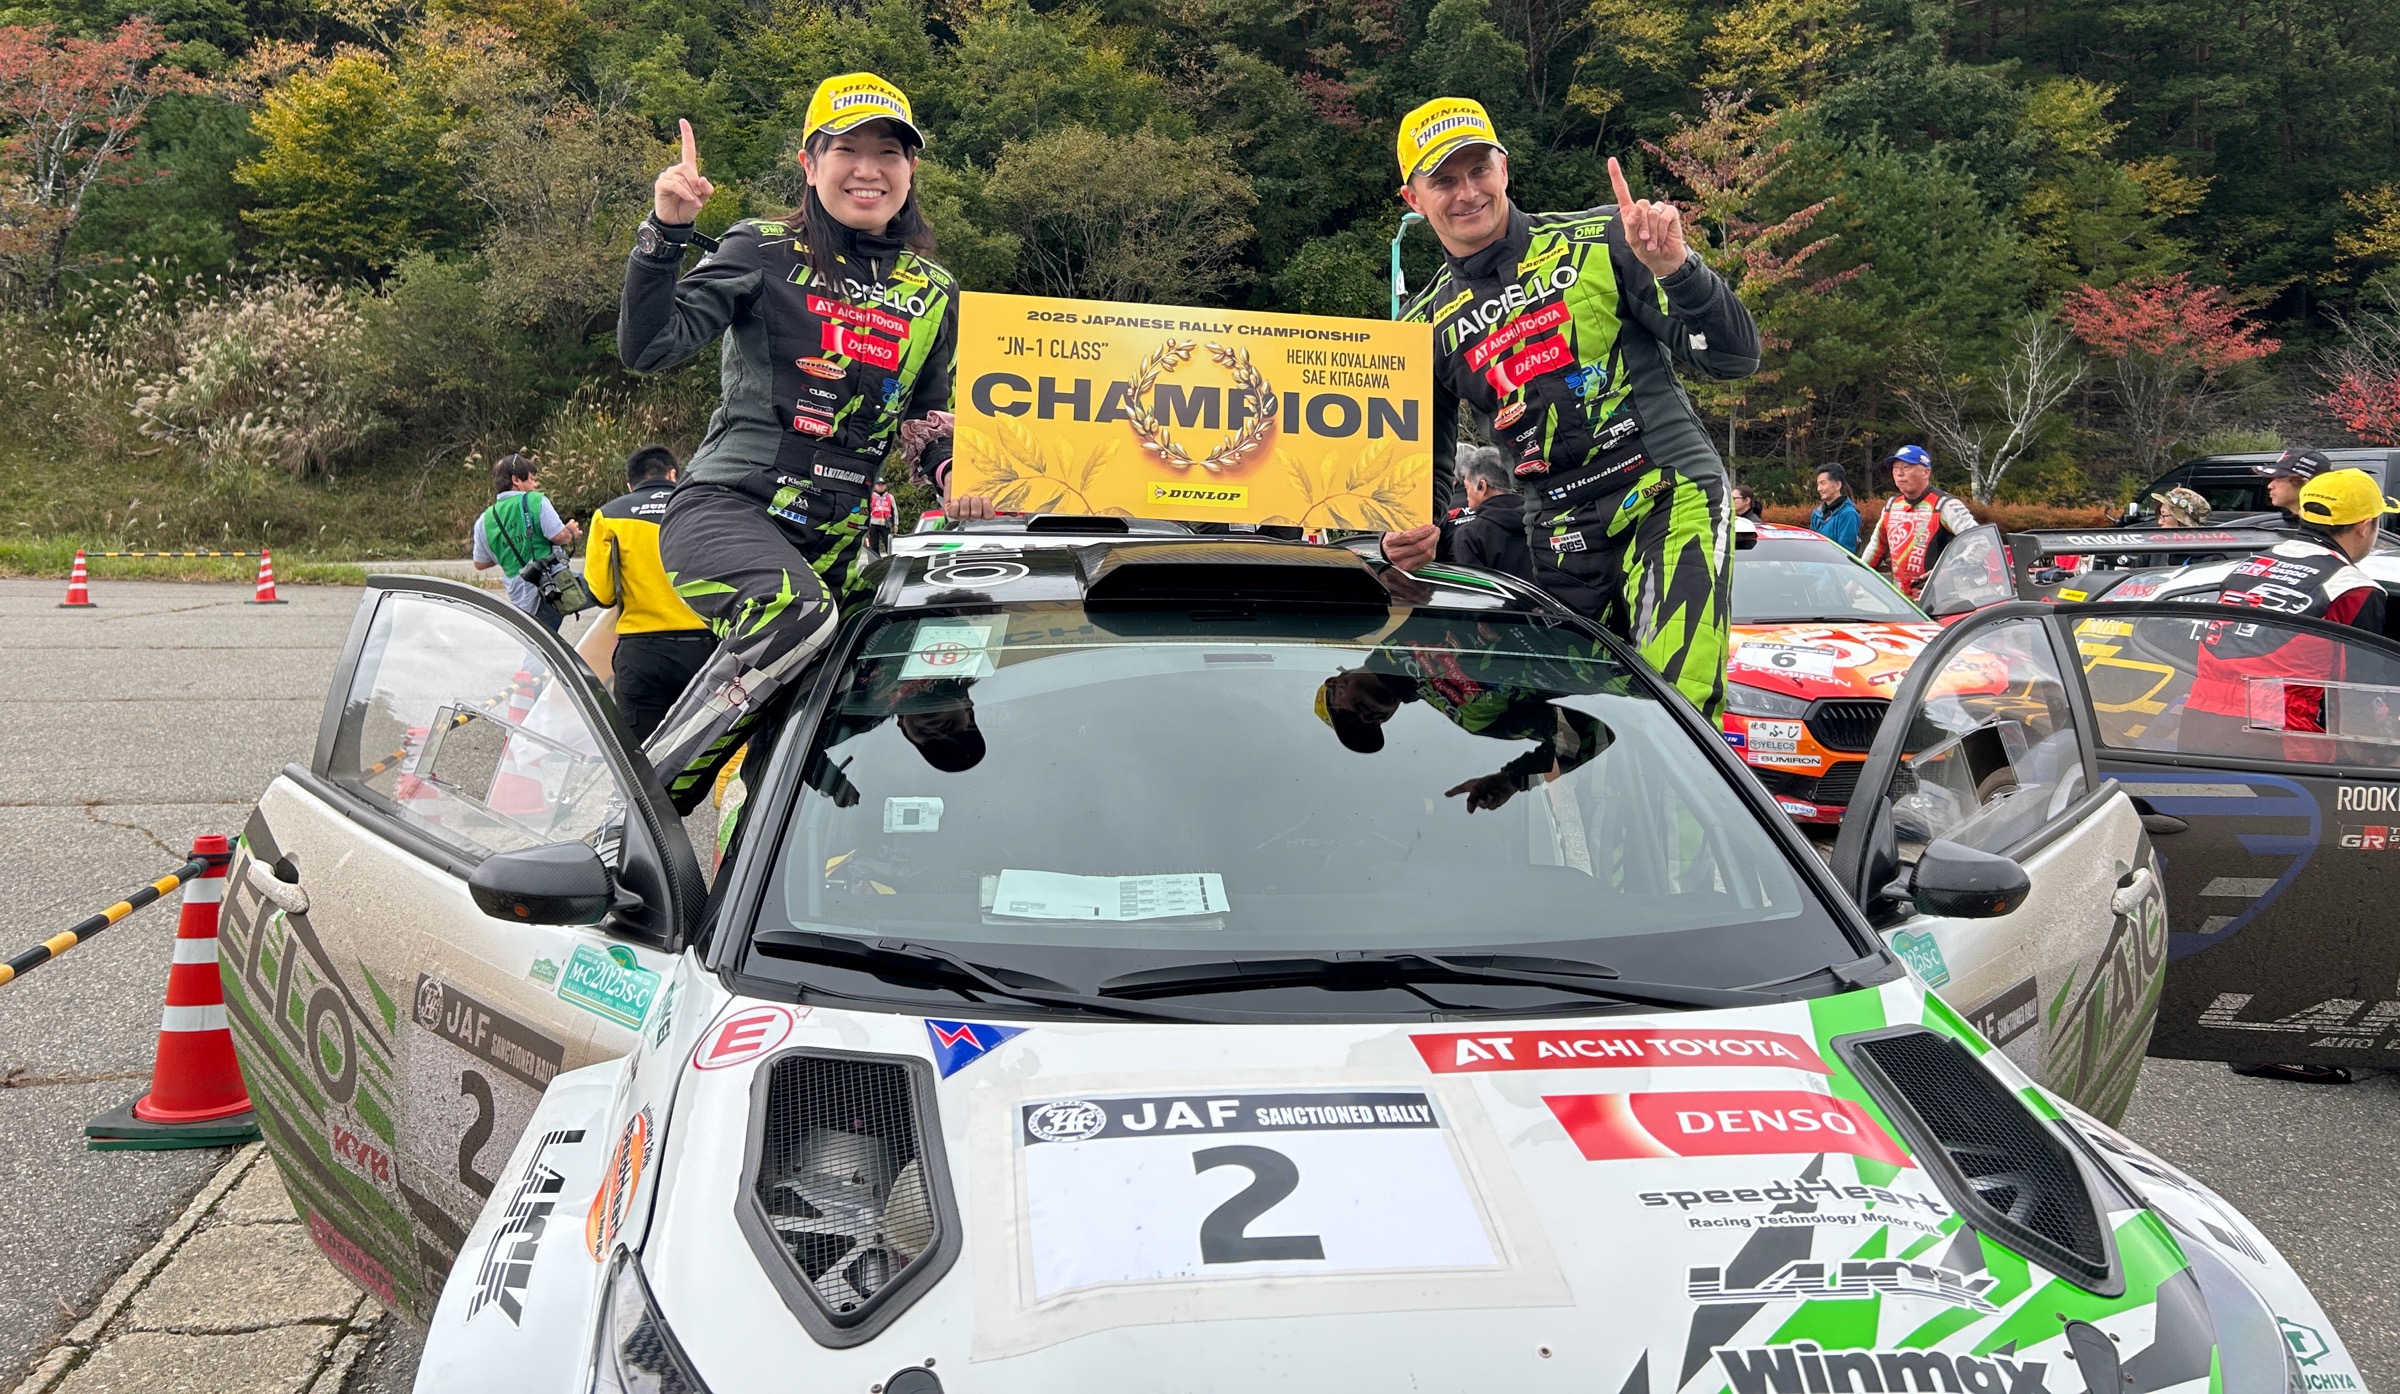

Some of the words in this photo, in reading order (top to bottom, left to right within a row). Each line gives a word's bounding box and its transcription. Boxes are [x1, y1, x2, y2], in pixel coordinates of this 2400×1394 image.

[841, 84, 905, 104] DUNLOP
[833, 94, 907, 120] CHAMPION
[1419, 107, 1480, 130] DUNLOP
[1416, 116, 1485, 150] CHAMPION
[759, 225, 785, 234] OMP
[1574, 225, 1605, 238] OMP
[1526, 247, 1564, 269] DUNLOP
[929, 270, 950, 286] OMP
[815, 300, 835, 313] AT
[837, 307, 870, 322] AICHI
[871, 314, 905, 333] TOYOTA
[1026, 310, 1078, 323] 2025
[1082, 314, 1176, 331] JAPANESE
[1179, 320, 1234, 334] RALLY
[1237, 324, 1371, 343] CHAMPIONSHIP
[1474, 344, 1490, 365] AT
[1490, 323, 1520, 349] AICHI
[1520, 310, 1561, 331] TOYOTA
[847, 339, 892, 360] DENSO
[1286, 349, 1327, 368] HEIKKI
[1330, 351, 1406, 372] KOVALAINEN
[1515, 346, 1560, 376] DENSO
[1302, 368, 1326, 386] SAE
[1329, 370, 1390, 390] KITAGAWA
[1565, 360, 1610, 390] SPK
[971, 372, 1420, 442] CHAMPION
[798, 418, 829, 435] TONE
[1566, 453, 1642, 491] H.Kovalainen
[1168, 488, 1242, 502] DUNLOP
[2066, 533, 2147, 546] ROOKIE
[2236, 562, 2265, 577] GR
[2260, 571, 2301, 586] Racing
[2267, 566, 2309, 579] GAZOO
[2276, 561, 2320, 575] TOYOTA
[2115, 584, 2160, 597] DENSO
[1764, 643, 1791, 651] JAF
[925, 652, 958, 665] 19
[1771, 651, 1797, 668] 6
[1769, 724, 1800, 739] ふじ
[1760, 755, 1821, 765] SUMIRON
[2341, 834, 2385, 849] GR
[615, 1001, 640, 1017] MASTERS
[446, 1000, 491, 1048] JAF
[490, 1032, 535, 1076] SANCTIONED
[709, 1014, 777, 1060] E
[1455, 1037, 1513, 1066] AT
[1537, 1039, 1644, 1058] AICHI
[1645, 1038, 1800, 1060] TOYOTA
[1121, 1099, 1240, 1132] JAF
[1256, 1105, 1374, 1127] SANCTIONED
[1376, 1104, 1432, 1125] RALLY
[1674, 1110, 1857, 1136] DENSO
[460, 1070, 496, 1199] 2
[1191, 1144, 1326, 1265] 2
[1688, 1216, 1752, 1229] Racing
[1754, 1212, 1857, 1226] Technology
[1861, 1212, 1910, 1228] Motor
[1912, 1220, 1942, 1237] OIL
[1712, 1341, 2048, 1394] Winmax
